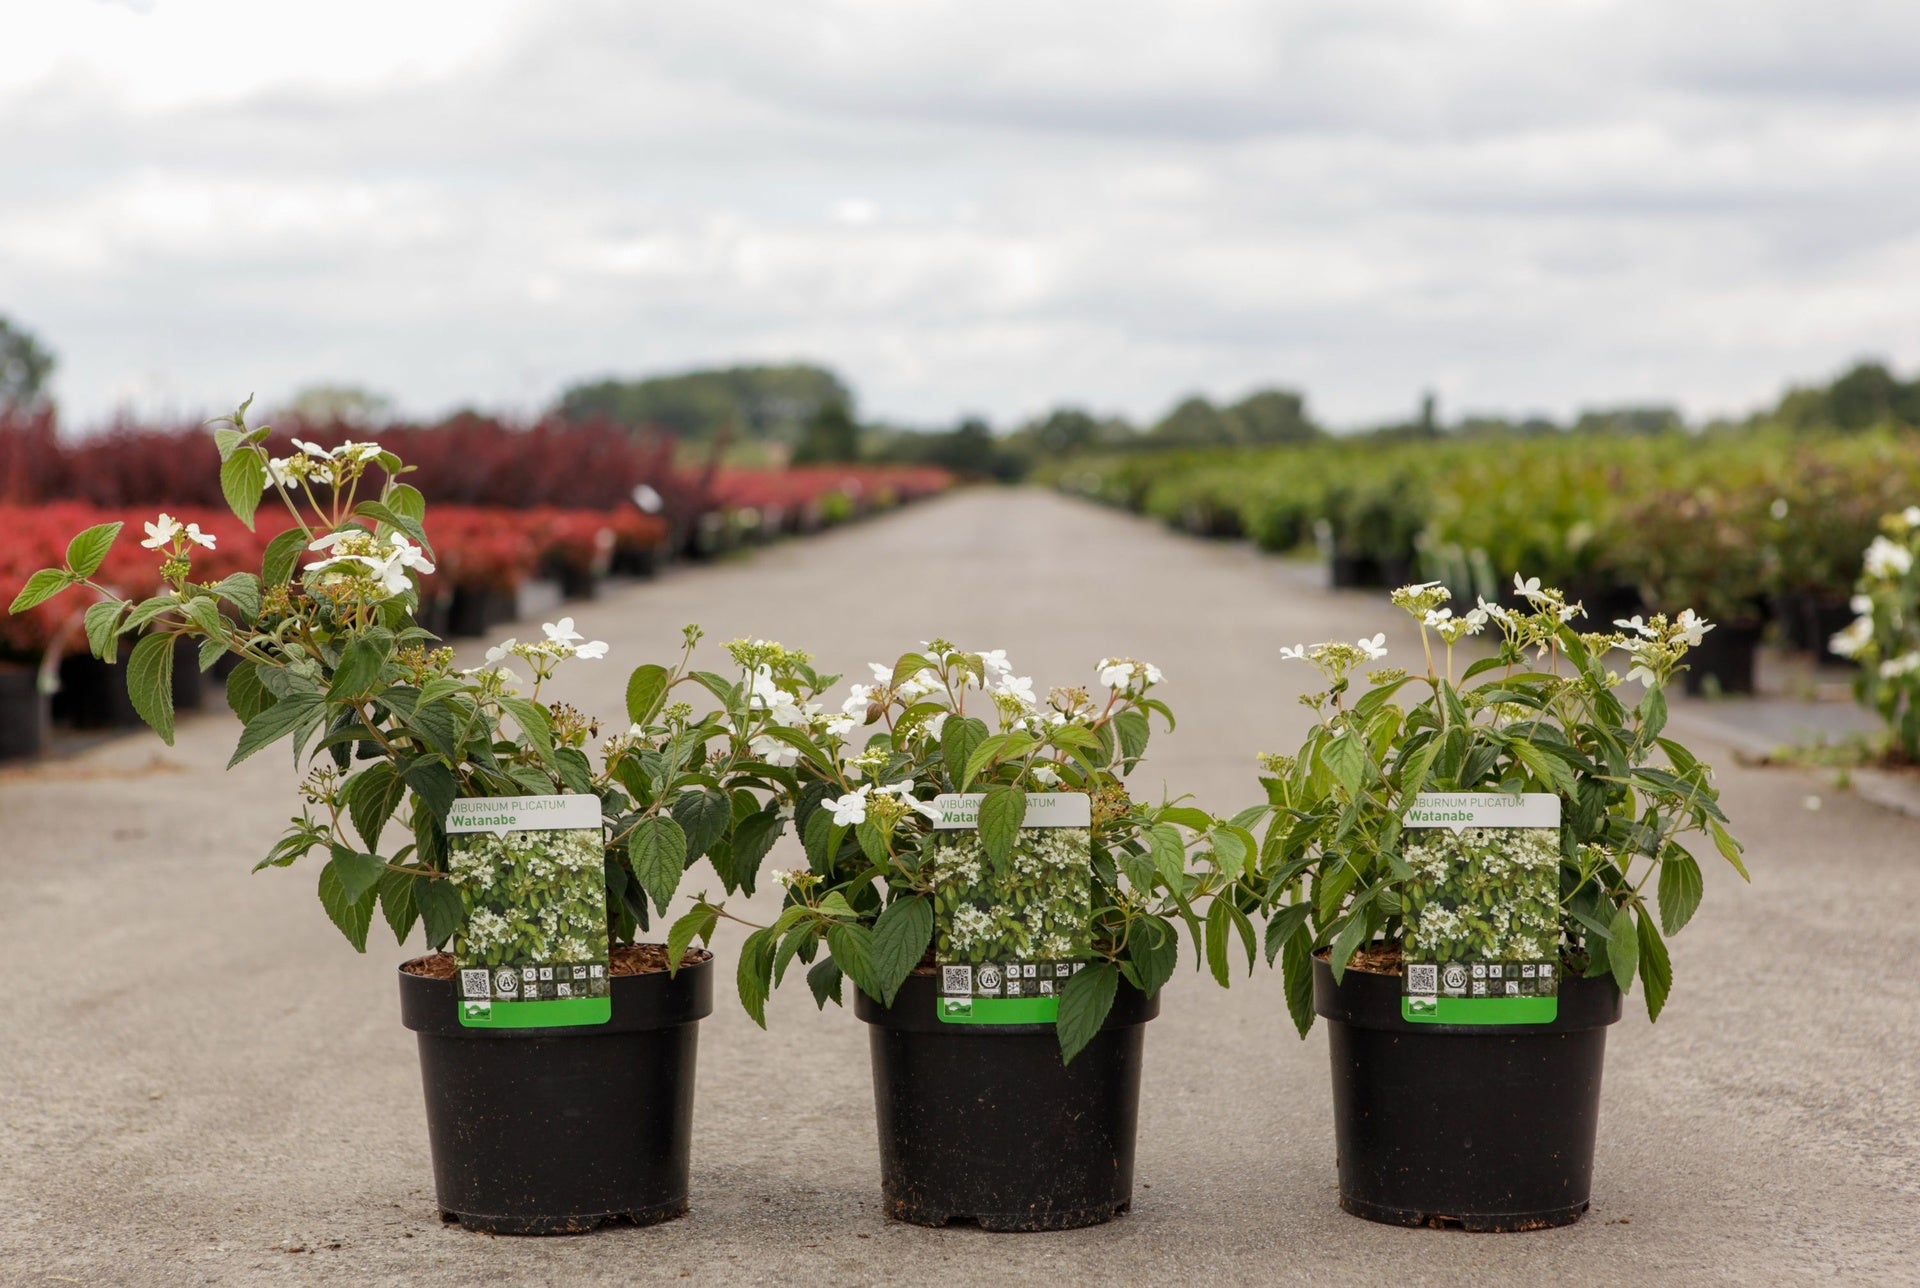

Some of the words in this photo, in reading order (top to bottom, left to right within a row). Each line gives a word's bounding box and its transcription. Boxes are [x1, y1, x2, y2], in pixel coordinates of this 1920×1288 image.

[451, 801, 508, 813] VIBURNUM
[511, 800, 566, 811] PLICATUM
[939, 799, 981, 809] VIBURN
[1416, 798, 1467, 808] IBURNUM
[1470, 798, 1525, 808] PLICATUM
[451, 814, 516, 827] Watanabe
[1409, 810, 1474, 822] Watanabe
